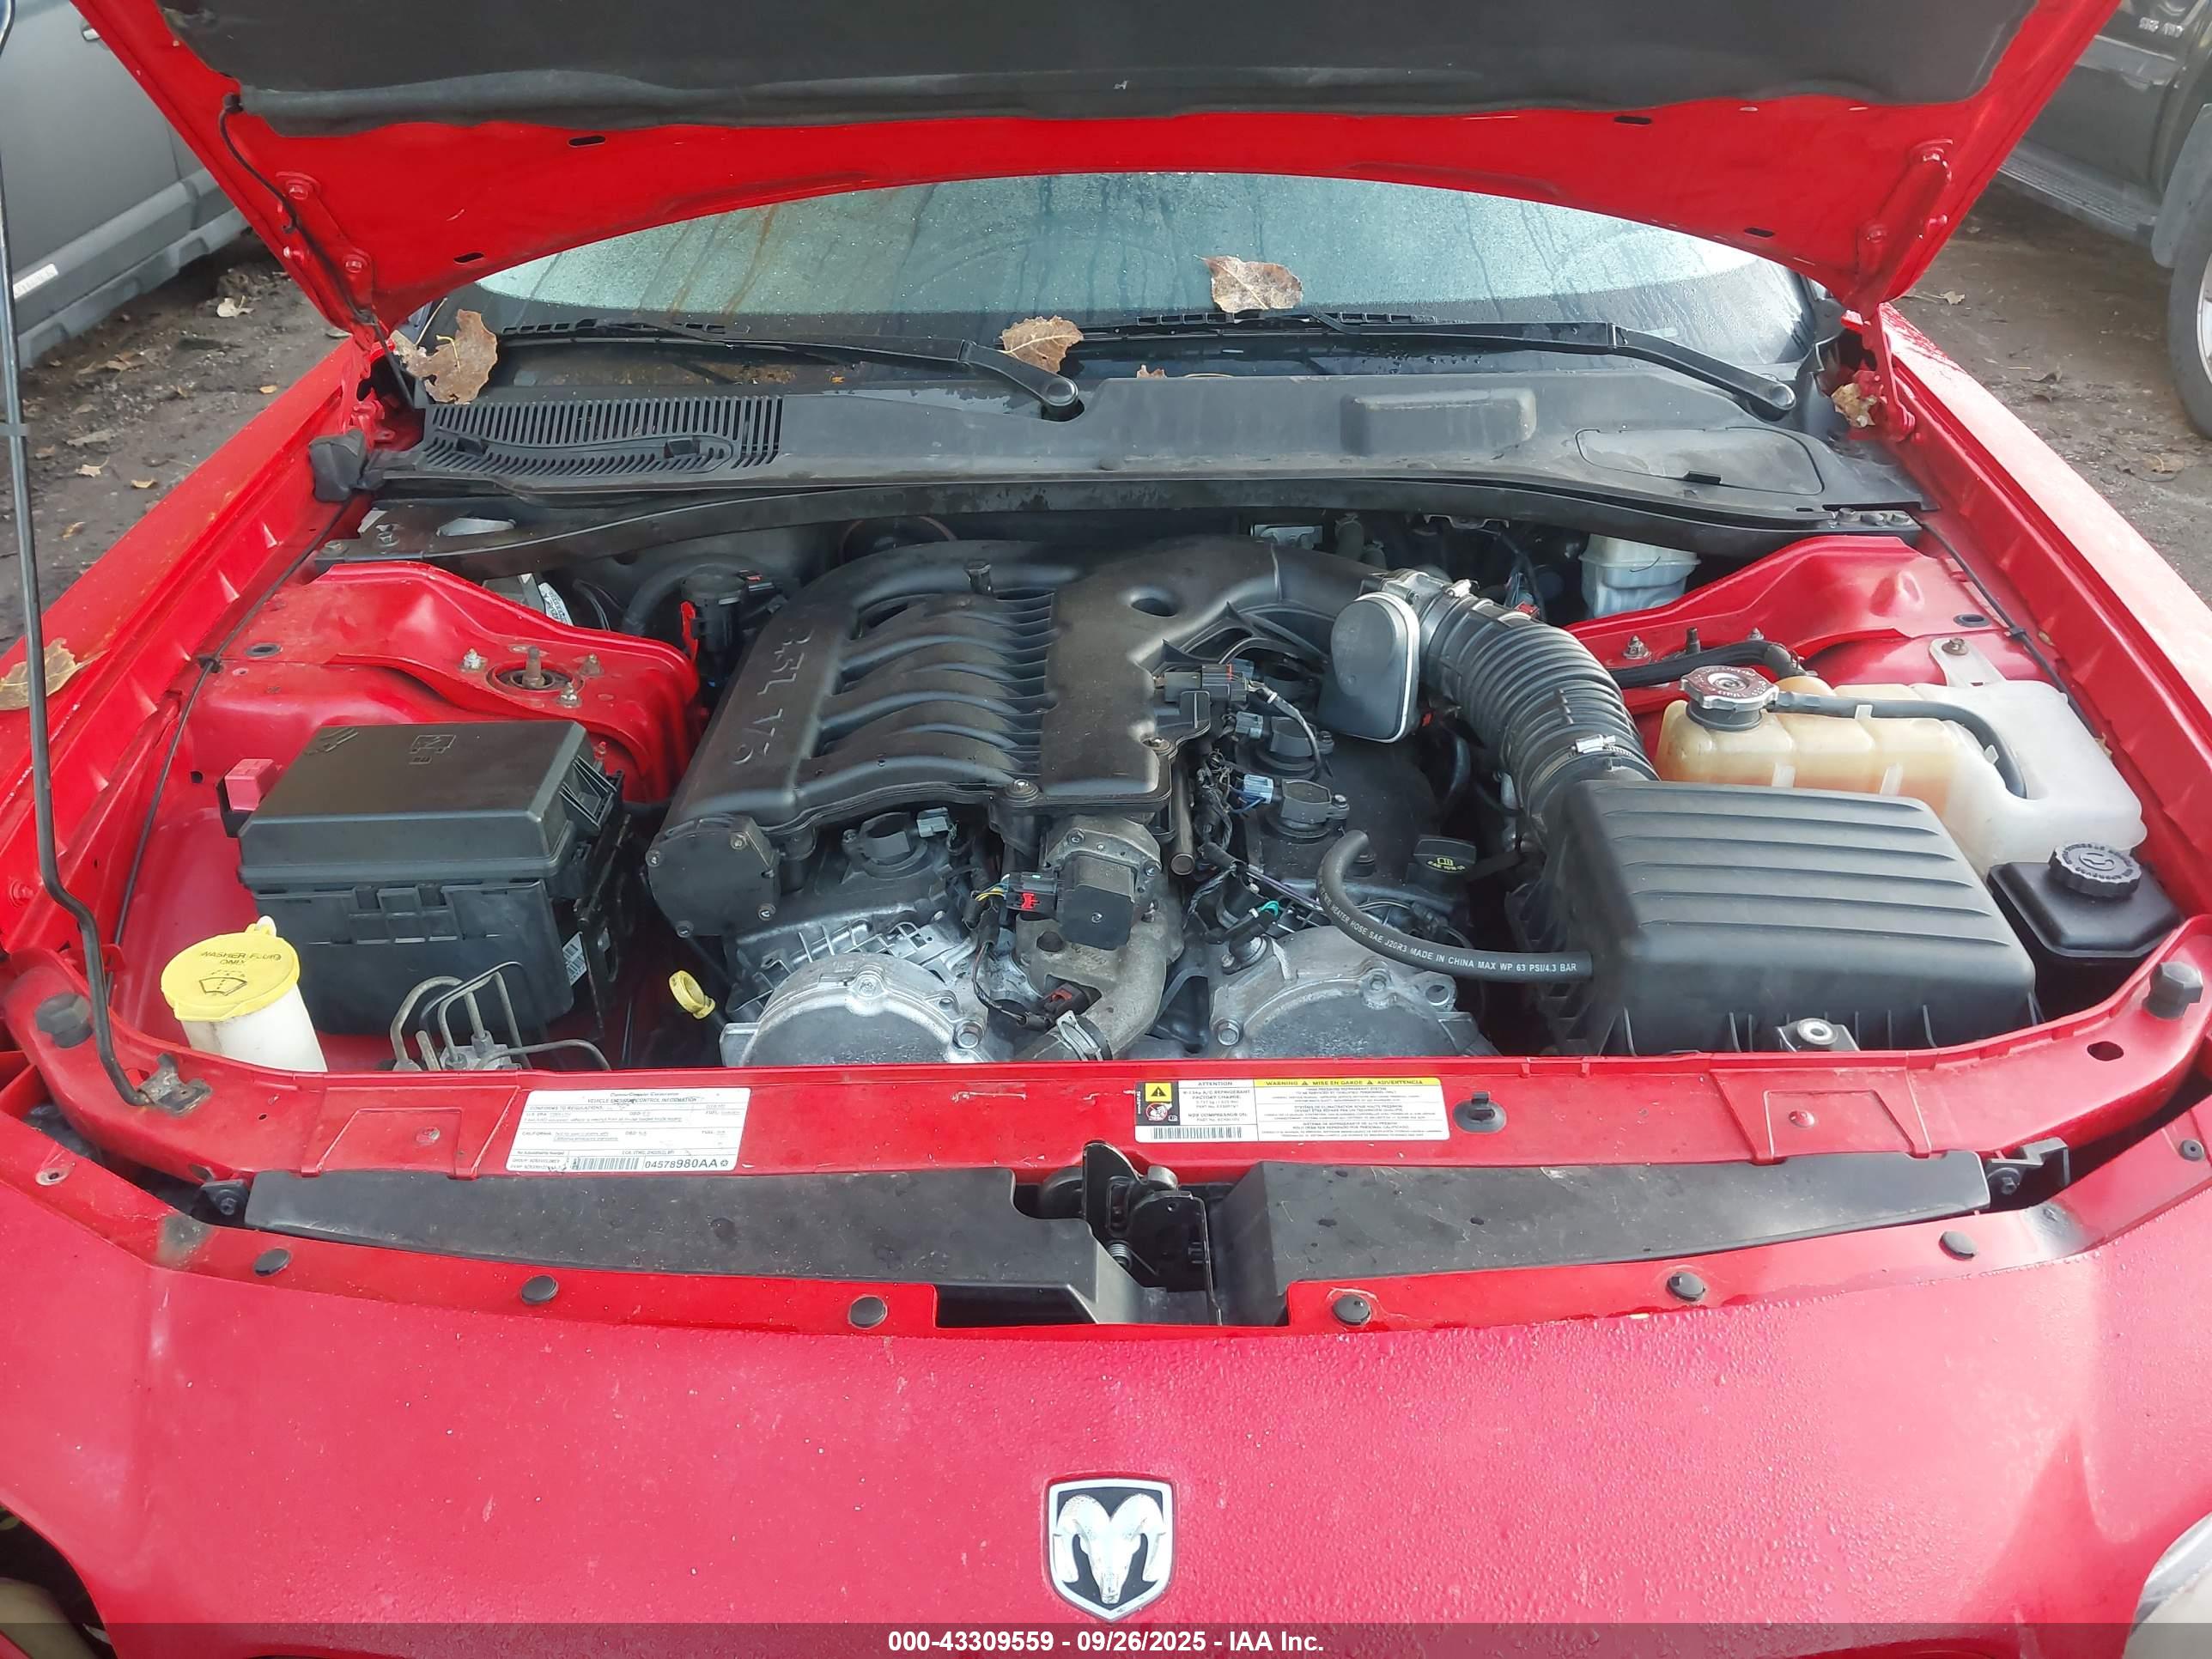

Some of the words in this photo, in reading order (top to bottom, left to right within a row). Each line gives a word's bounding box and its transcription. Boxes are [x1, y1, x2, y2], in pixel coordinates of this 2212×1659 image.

[732, 707, 783, 765] V6
[201, 951, 246, 959] WASHER
[1331, 904, 1350, 925] HEATER
[1350, 921, 1368, 936] HOSE
[1368, 931, 1383, 944] SAE
[1383, 939, 1407, 953] J20R3
[1409, 947, 1434, 960] MADE
[1436, 953, 1446, 963] IN
[1448, 956, 1474, 969] CHINA
[1477, 960, 1497, 971] MAX
[1499, 963, 1513, 972] WP
[1516, 963, 1526, 972] 63
[1528, 963, 1557, 973] PSI/4.3
[1559, 963, 1577, 972] BAR
[645, 1158, 718, 1170] 04578980AA
